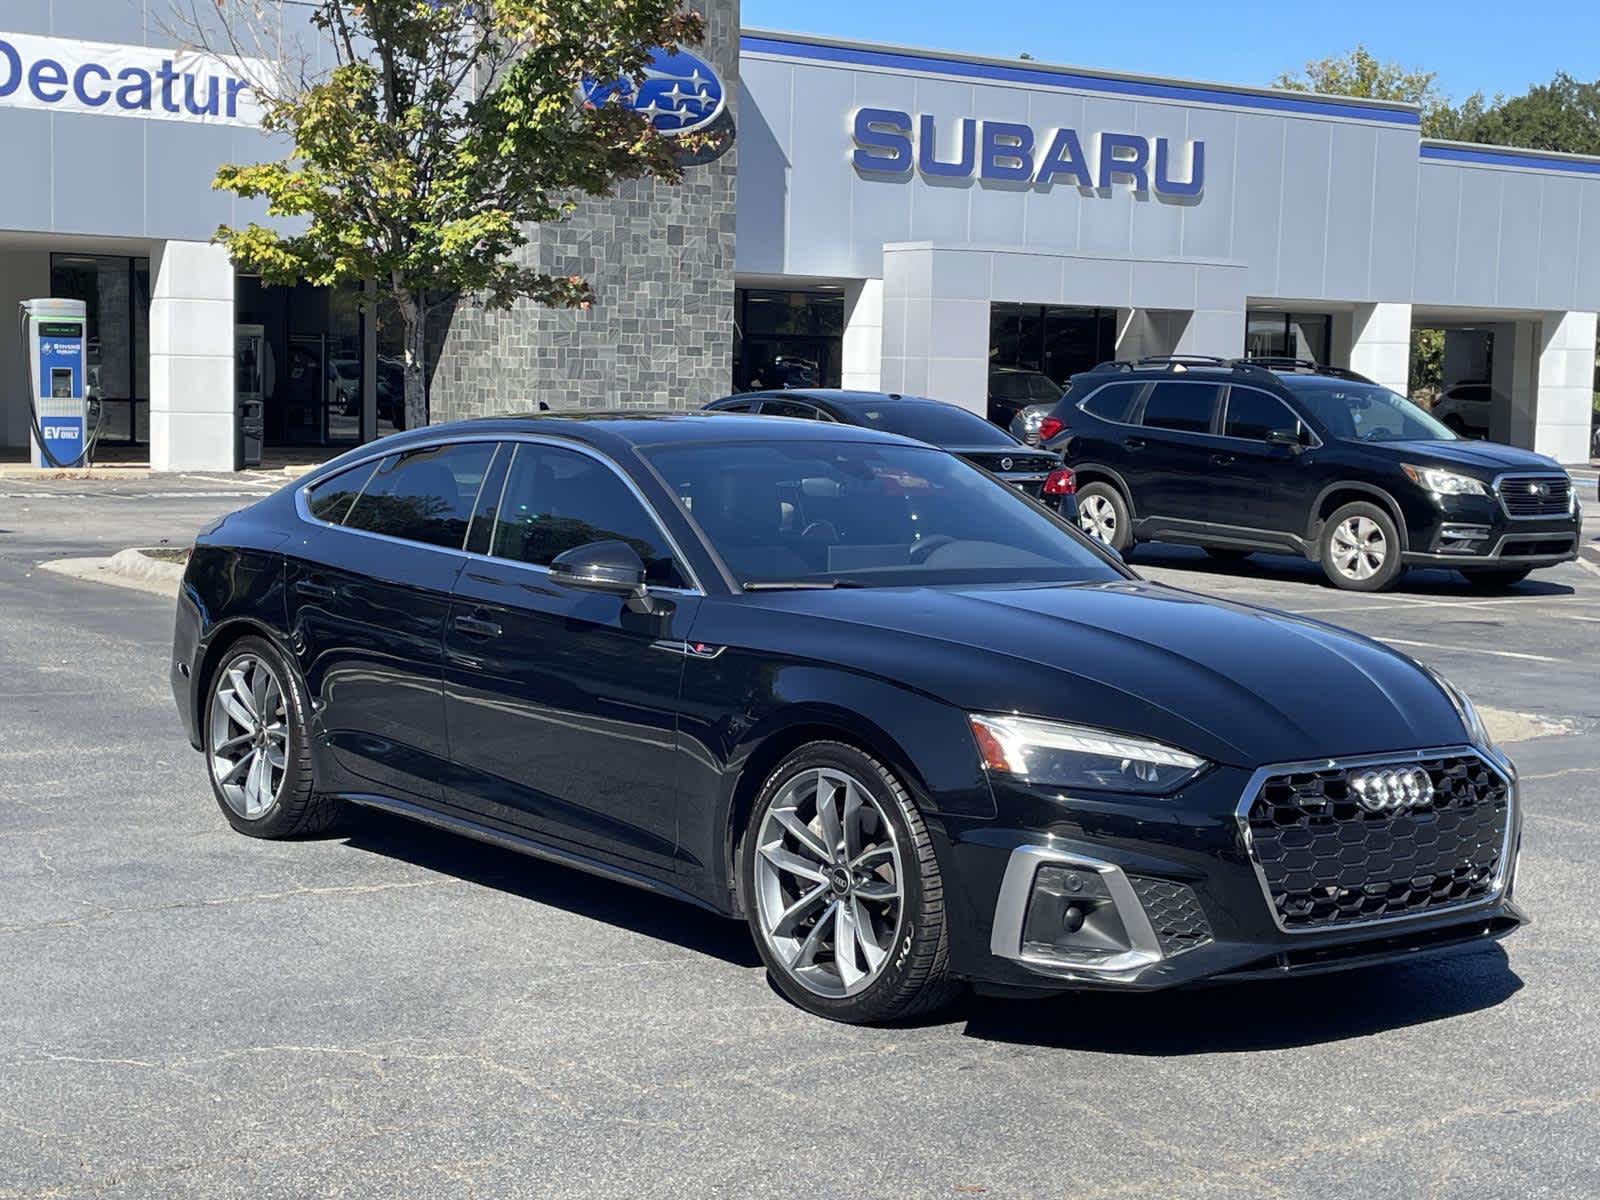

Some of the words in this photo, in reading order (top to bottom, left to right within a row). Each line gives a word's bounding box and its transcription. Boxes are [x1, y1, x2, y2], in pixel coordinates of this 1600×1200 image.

[853, 107, 1205, 199] SUBARU
[44, 426, 60, 440] EV
[60, 431, 79, 440] ONLY
